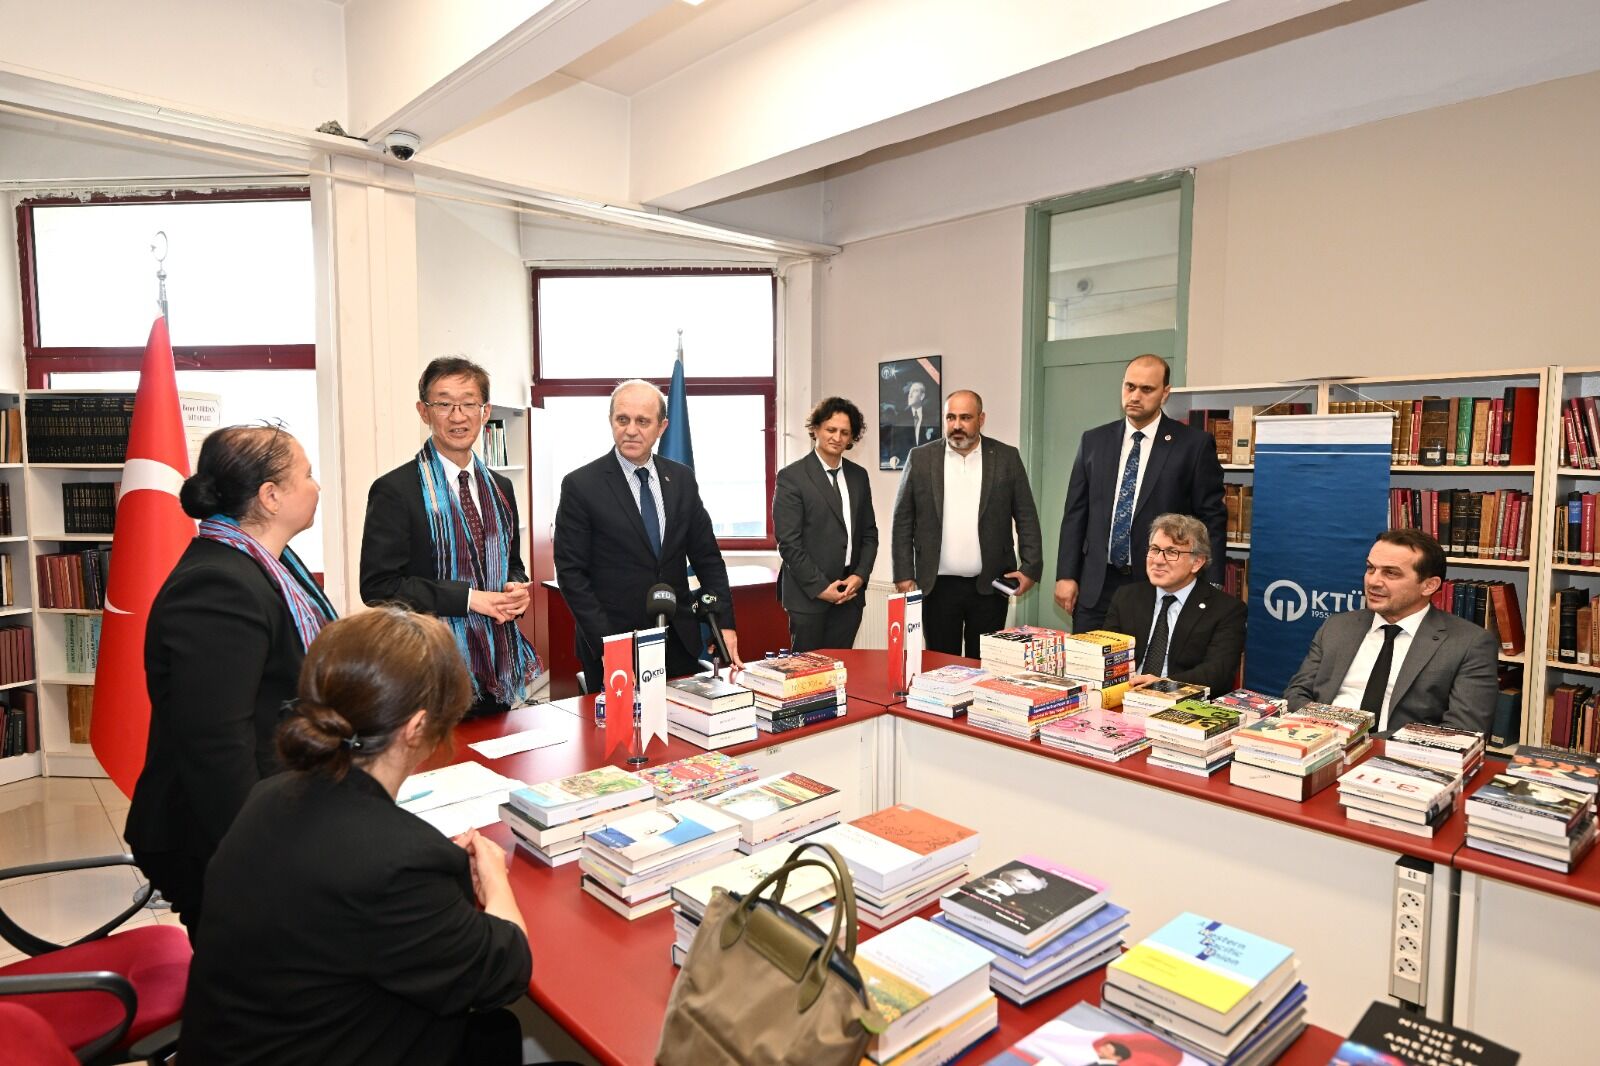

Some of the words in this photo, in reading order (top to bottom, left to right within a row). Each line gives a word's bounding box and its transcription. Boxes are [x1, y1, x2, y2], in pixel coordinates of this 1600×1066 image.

[1311, 589, 1366, 612] KTÜ
[652, 667, 665, 677] KTÜ
[1398, 1017, 1457, 1043] NIGHT
[1461, 1039, 1484, 1055] IN
[1418, 1033, 1454, 1053] THE
